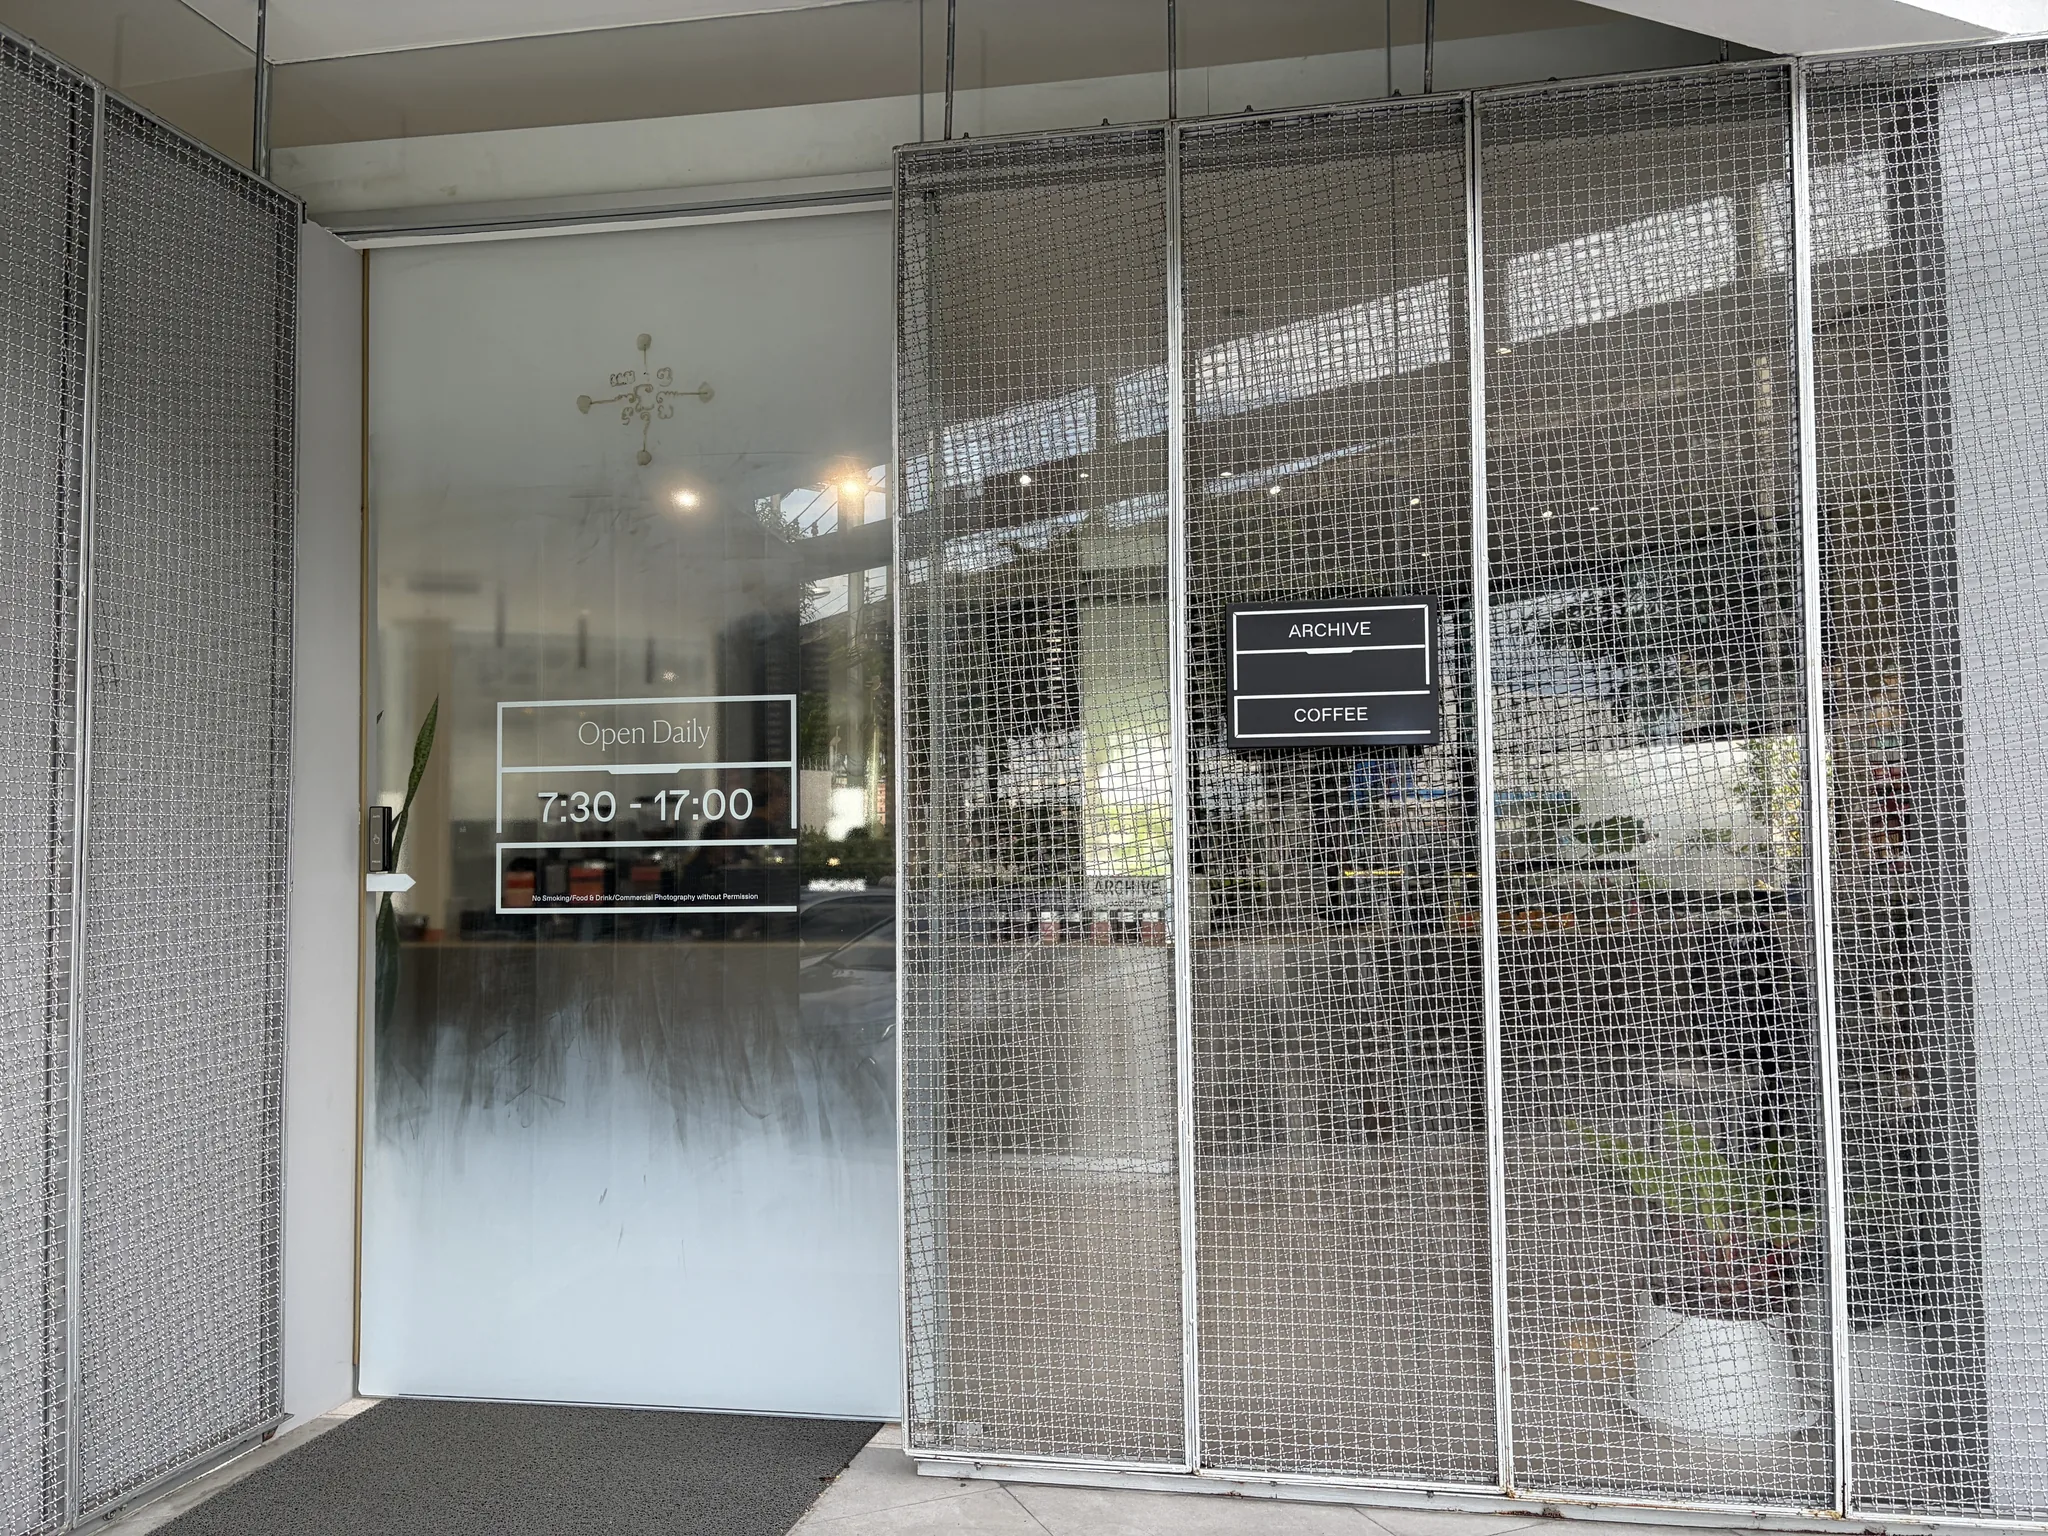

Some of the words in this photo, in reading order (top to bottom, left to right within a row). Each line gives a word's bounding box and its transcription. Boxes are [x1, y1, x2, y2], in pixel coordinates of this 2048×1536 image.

[1288, 621, 1372, 638] ARCHIVE
[1293, 706, 1369, 723] COFFEE
[578, 721, 646, 752] Open
[652, 717, 711, 749] Daily
[537, 790, 617, 823] 7:30
[654, 788, 754, 821] 17:00
[1095, 880, 1160, 896] ARCHIVE
[531, 894, 541, 902] No
[542, 894, 589, 903] Smoking/Food
[589, 894, 595, 902] &
[595, 893, 654, 902] Drink/Commercial
[654, 893, 696, 902] Photography
[696, 892, 722, 901] without
[722, 892, 759, 901] Permission
